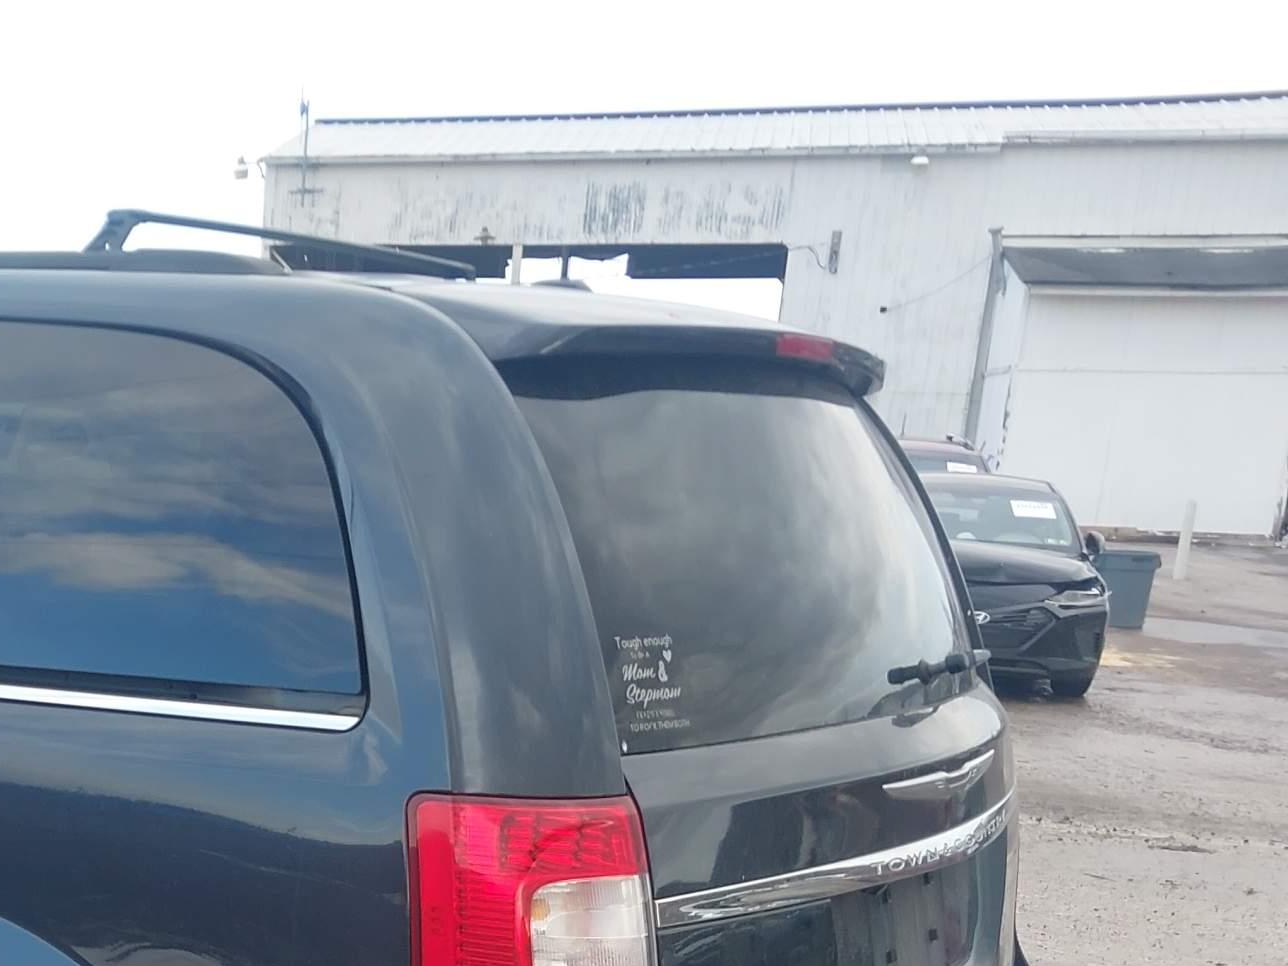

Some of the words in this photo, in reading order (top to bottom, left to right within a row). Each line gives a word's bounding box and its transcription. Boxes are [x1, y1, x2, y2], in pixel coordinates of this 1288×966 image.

[614, 635, 642, 650] Tough
[643, 633, 672, 649] enough
[622, 662, 656, 681] Mom
[626, 683, 681, 709] Stepmom
[871, 848, 939, 875] TOWN
